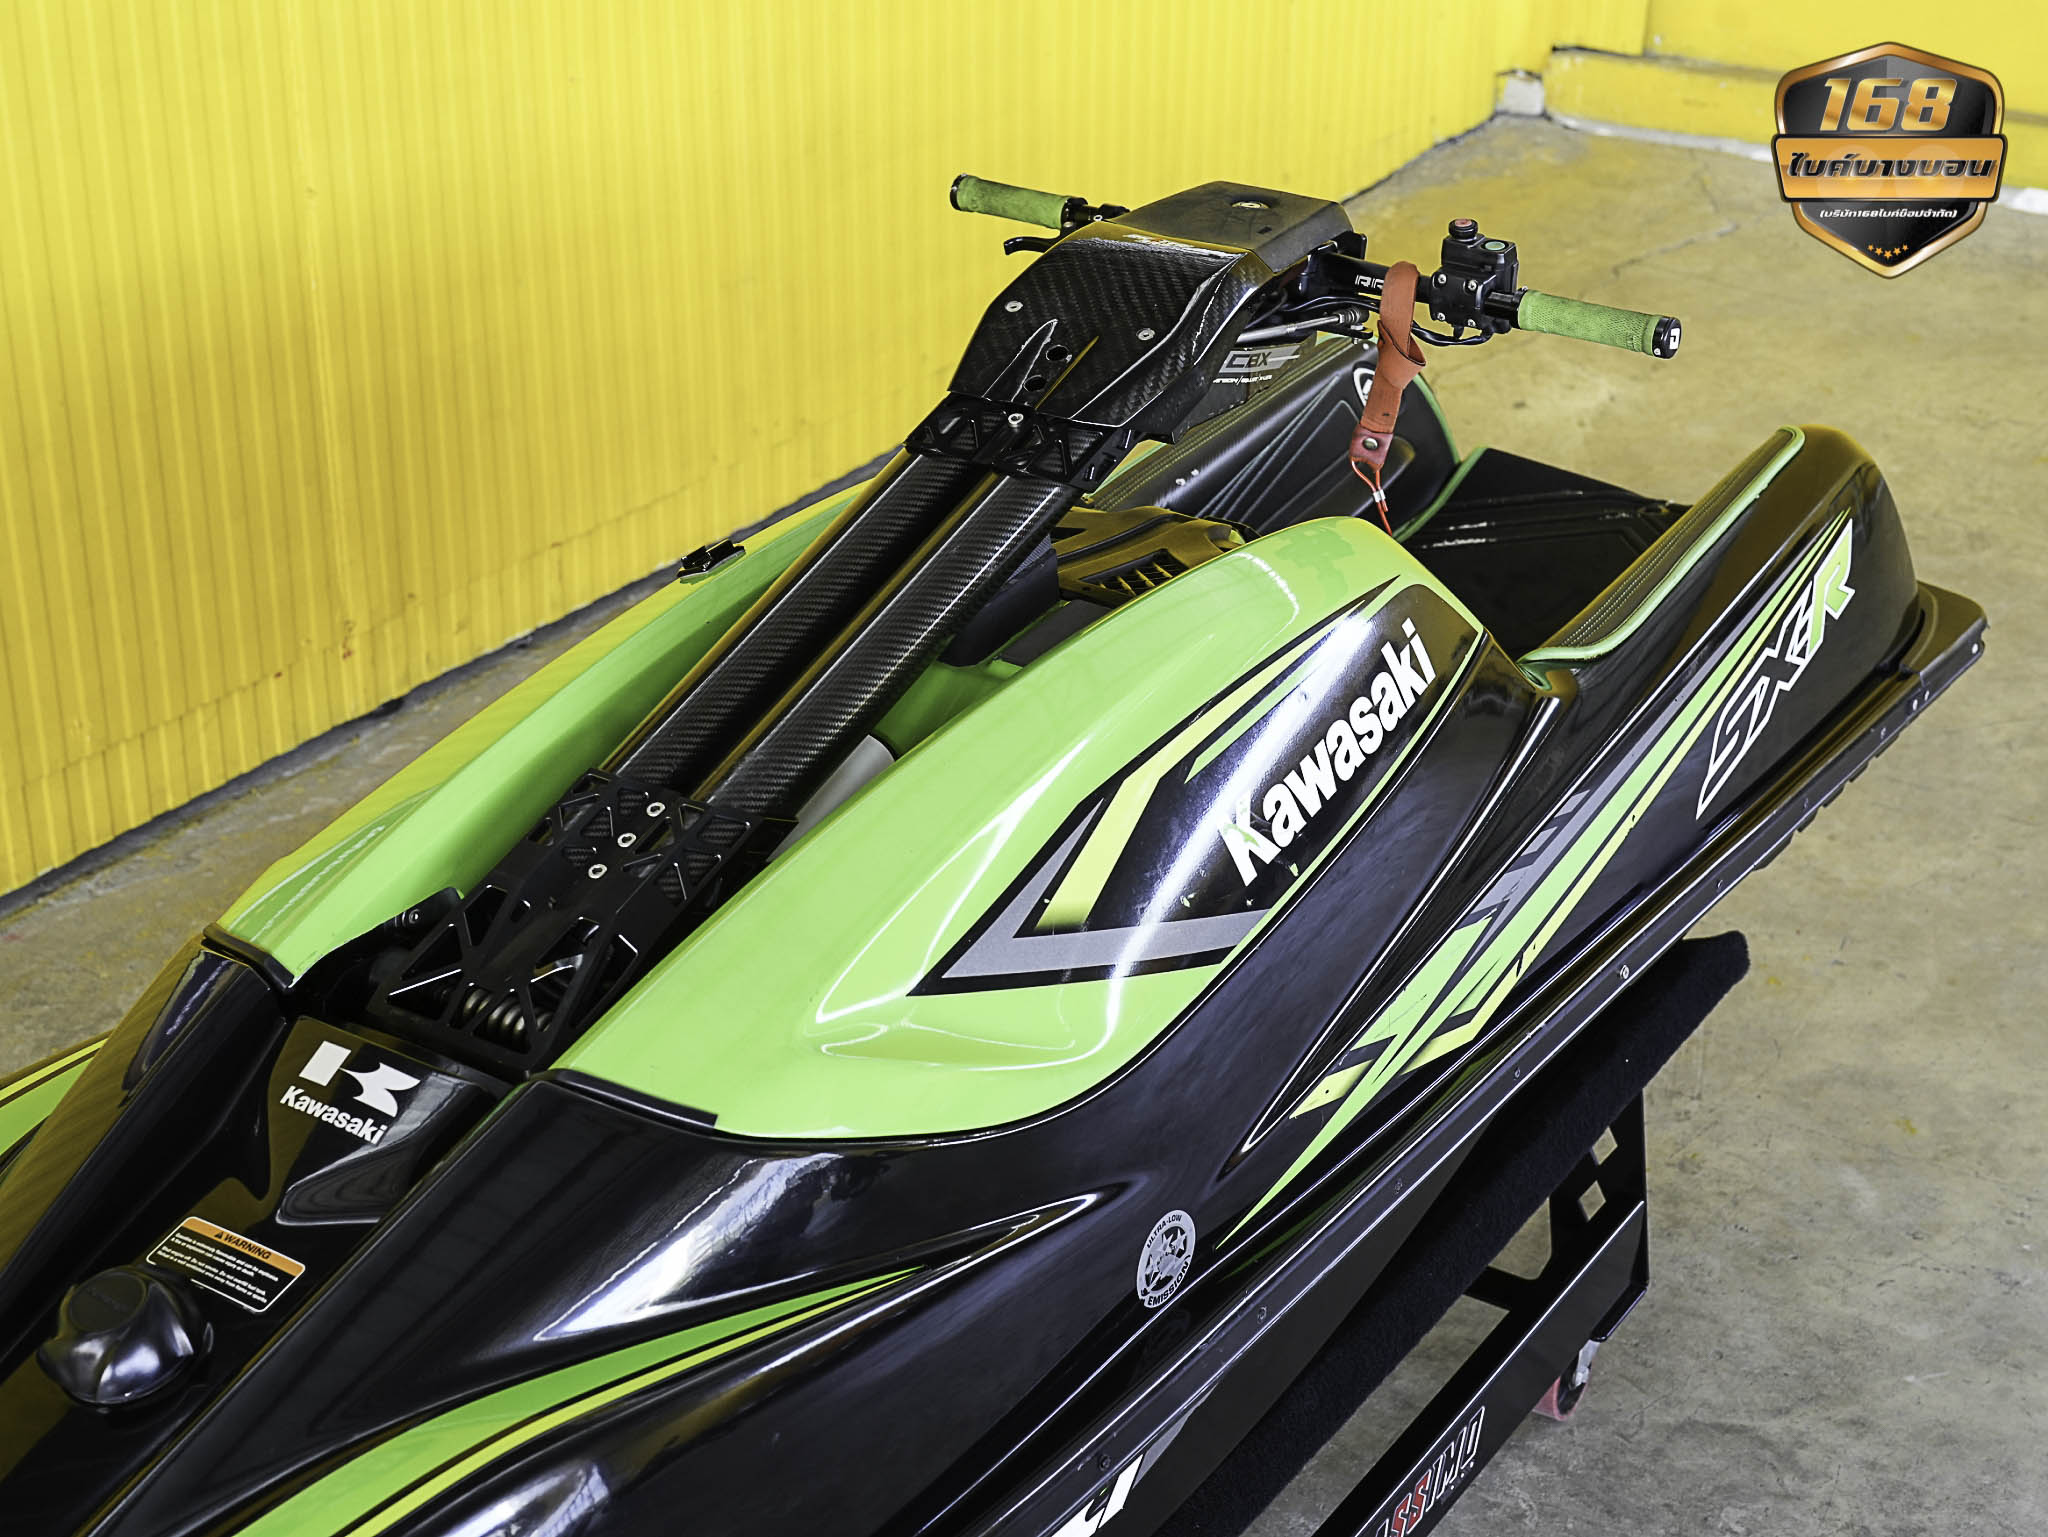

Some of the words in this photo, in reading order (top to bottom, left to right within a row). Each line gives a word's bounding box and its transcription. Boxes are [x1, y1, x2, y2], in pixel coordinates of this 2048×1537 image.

[1217, 617, 1437, 887] Kawasaki
[280, 1086, 389, 1146] Kawasaki
[224, 1233, 272, 1260] WARNING
[1146, 1214, 1183, 1249] ULTRA-LOW
[1147, 1260, 1189, 1306] EMISSION
